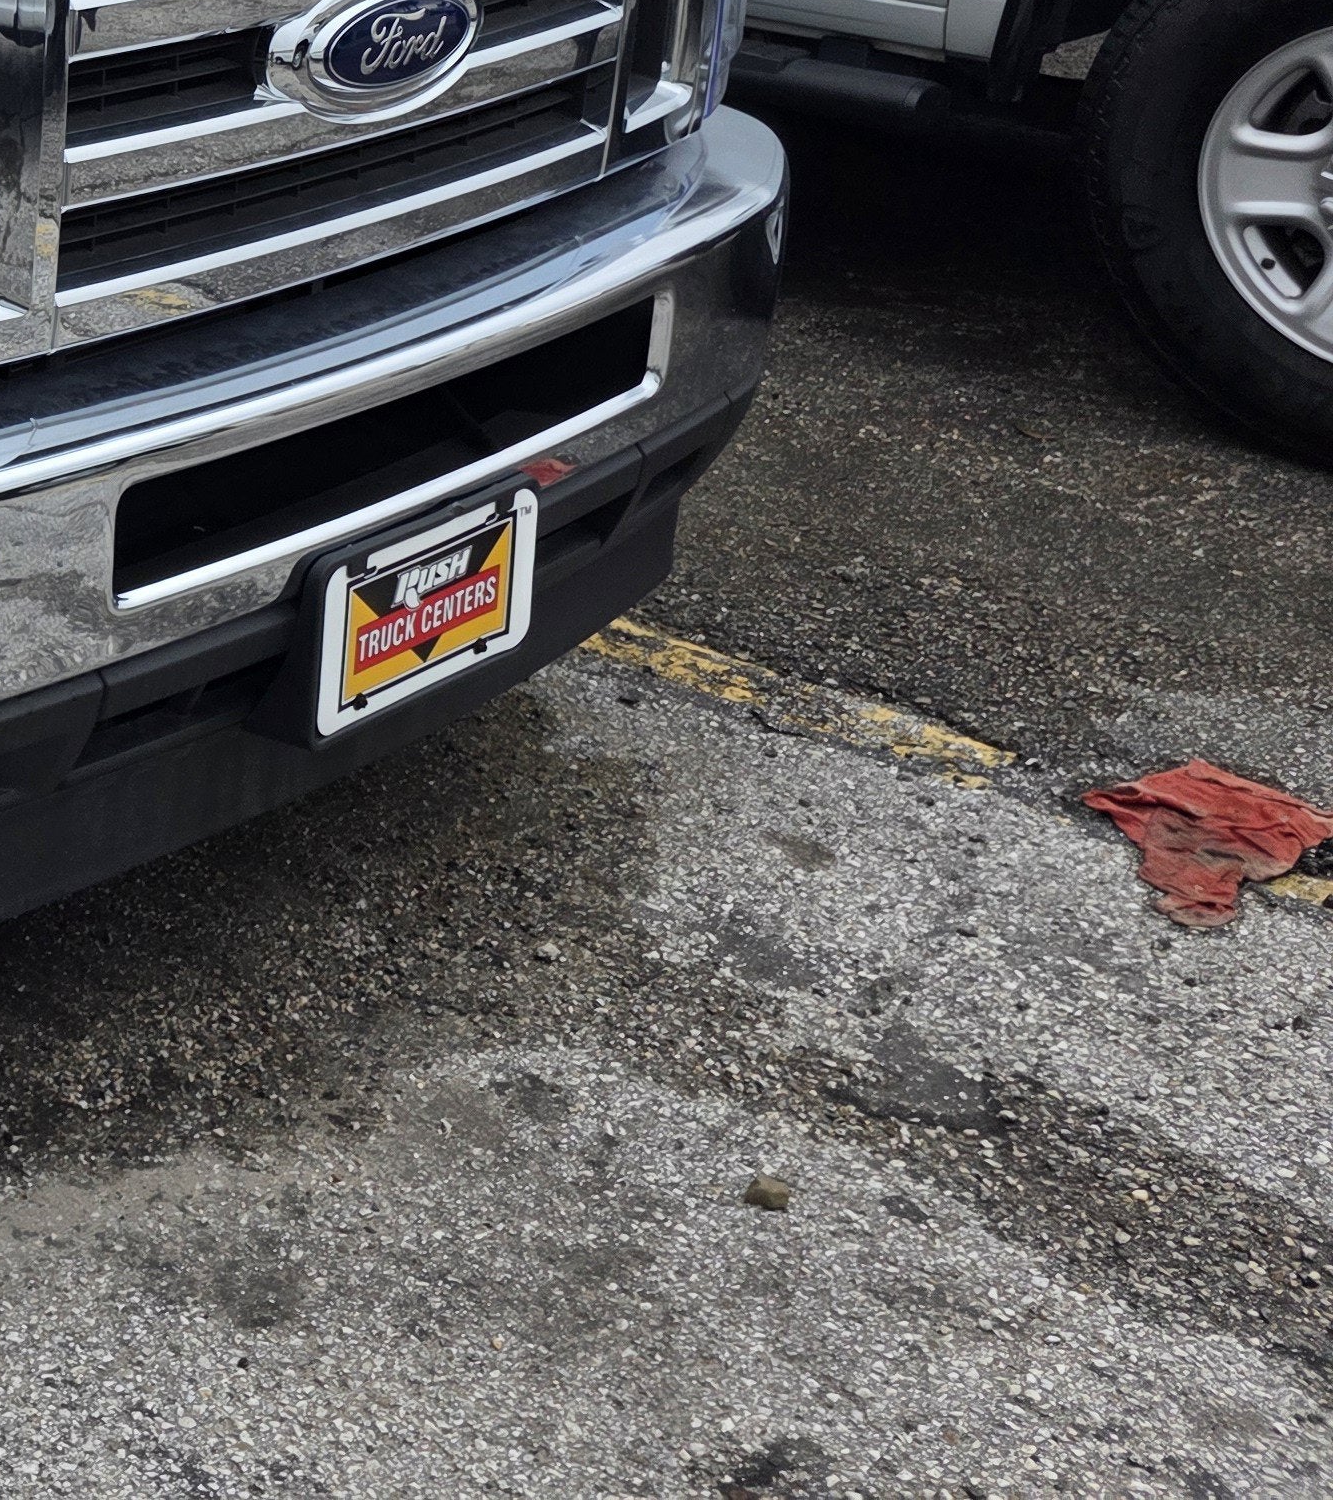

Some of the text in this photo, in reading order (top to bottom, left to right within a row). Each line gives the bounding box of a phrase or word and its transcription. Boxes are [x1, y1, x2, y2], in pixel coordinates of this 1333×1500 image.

[360, 7, 447, 76] Ford
[358, 575, 497, 662] TRUCK CENTERS
